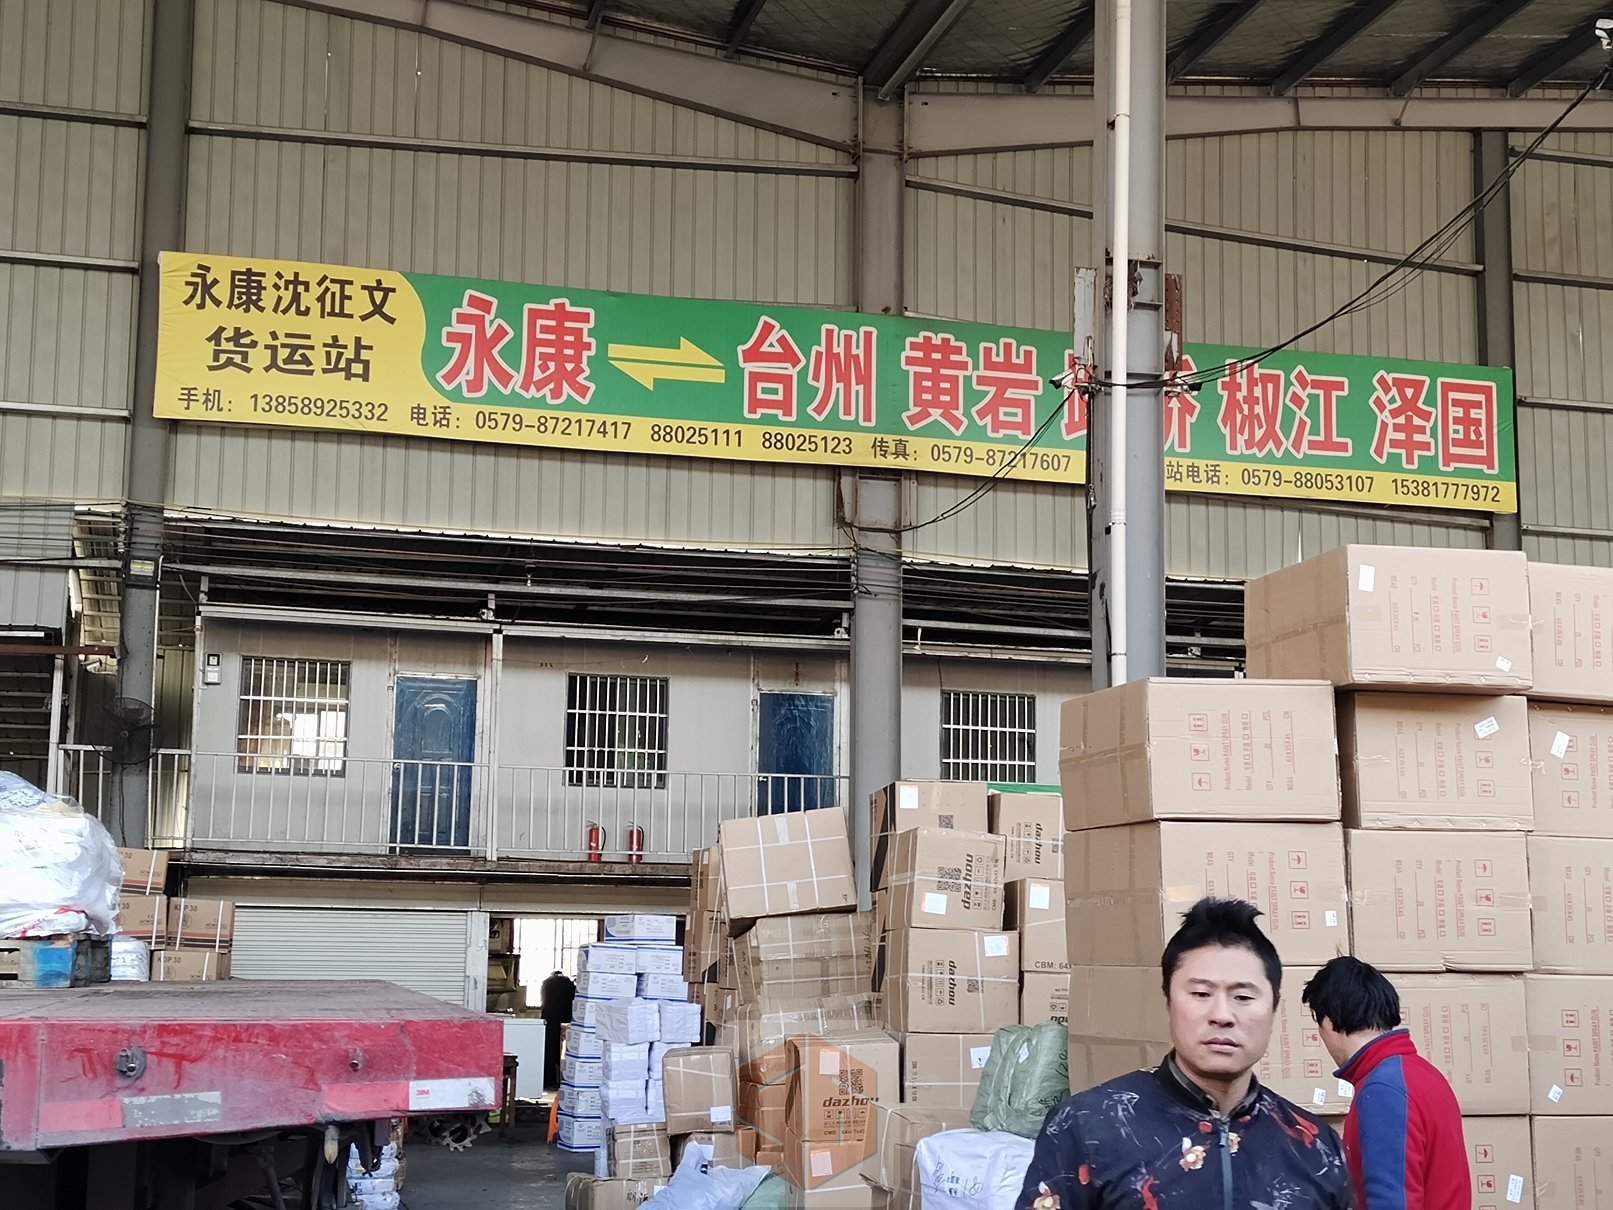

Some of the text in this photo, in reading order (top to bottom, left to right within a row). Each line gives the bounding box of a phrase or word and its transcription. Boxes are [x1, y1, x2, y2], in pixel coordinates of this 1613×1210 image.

[182, 264, 398, 325] 永康沈征文
[204, 325, 375, 383] 货运站
[437, 289, 597, 404] 永康
[737, 314, 878, 428] 台州
[901, 331, 1043, 440] 黄岩
[1217, 357, 1352, 459] 椒江
[1369, 369, 1499, 473] 泽国
[177, 387, 233, 413] 手机：
[250, 393, 389, 422] 13858925332
[409, 403, 461, 430] 电话：
[475, 410, 632, 440] 0579-87217417
[650, 423, 744, 448] 88025111
[761, 431, 854, 455] 88025123
[870, 437, 919, 462] 传真：
[930, 443, 1072, 473] 0579-87217607
[1241, 469, 1375, 494] 0579-88053107
[1391, 478, 1501, 504] 15381777972
[961, 853, 973, 910] dazhou
